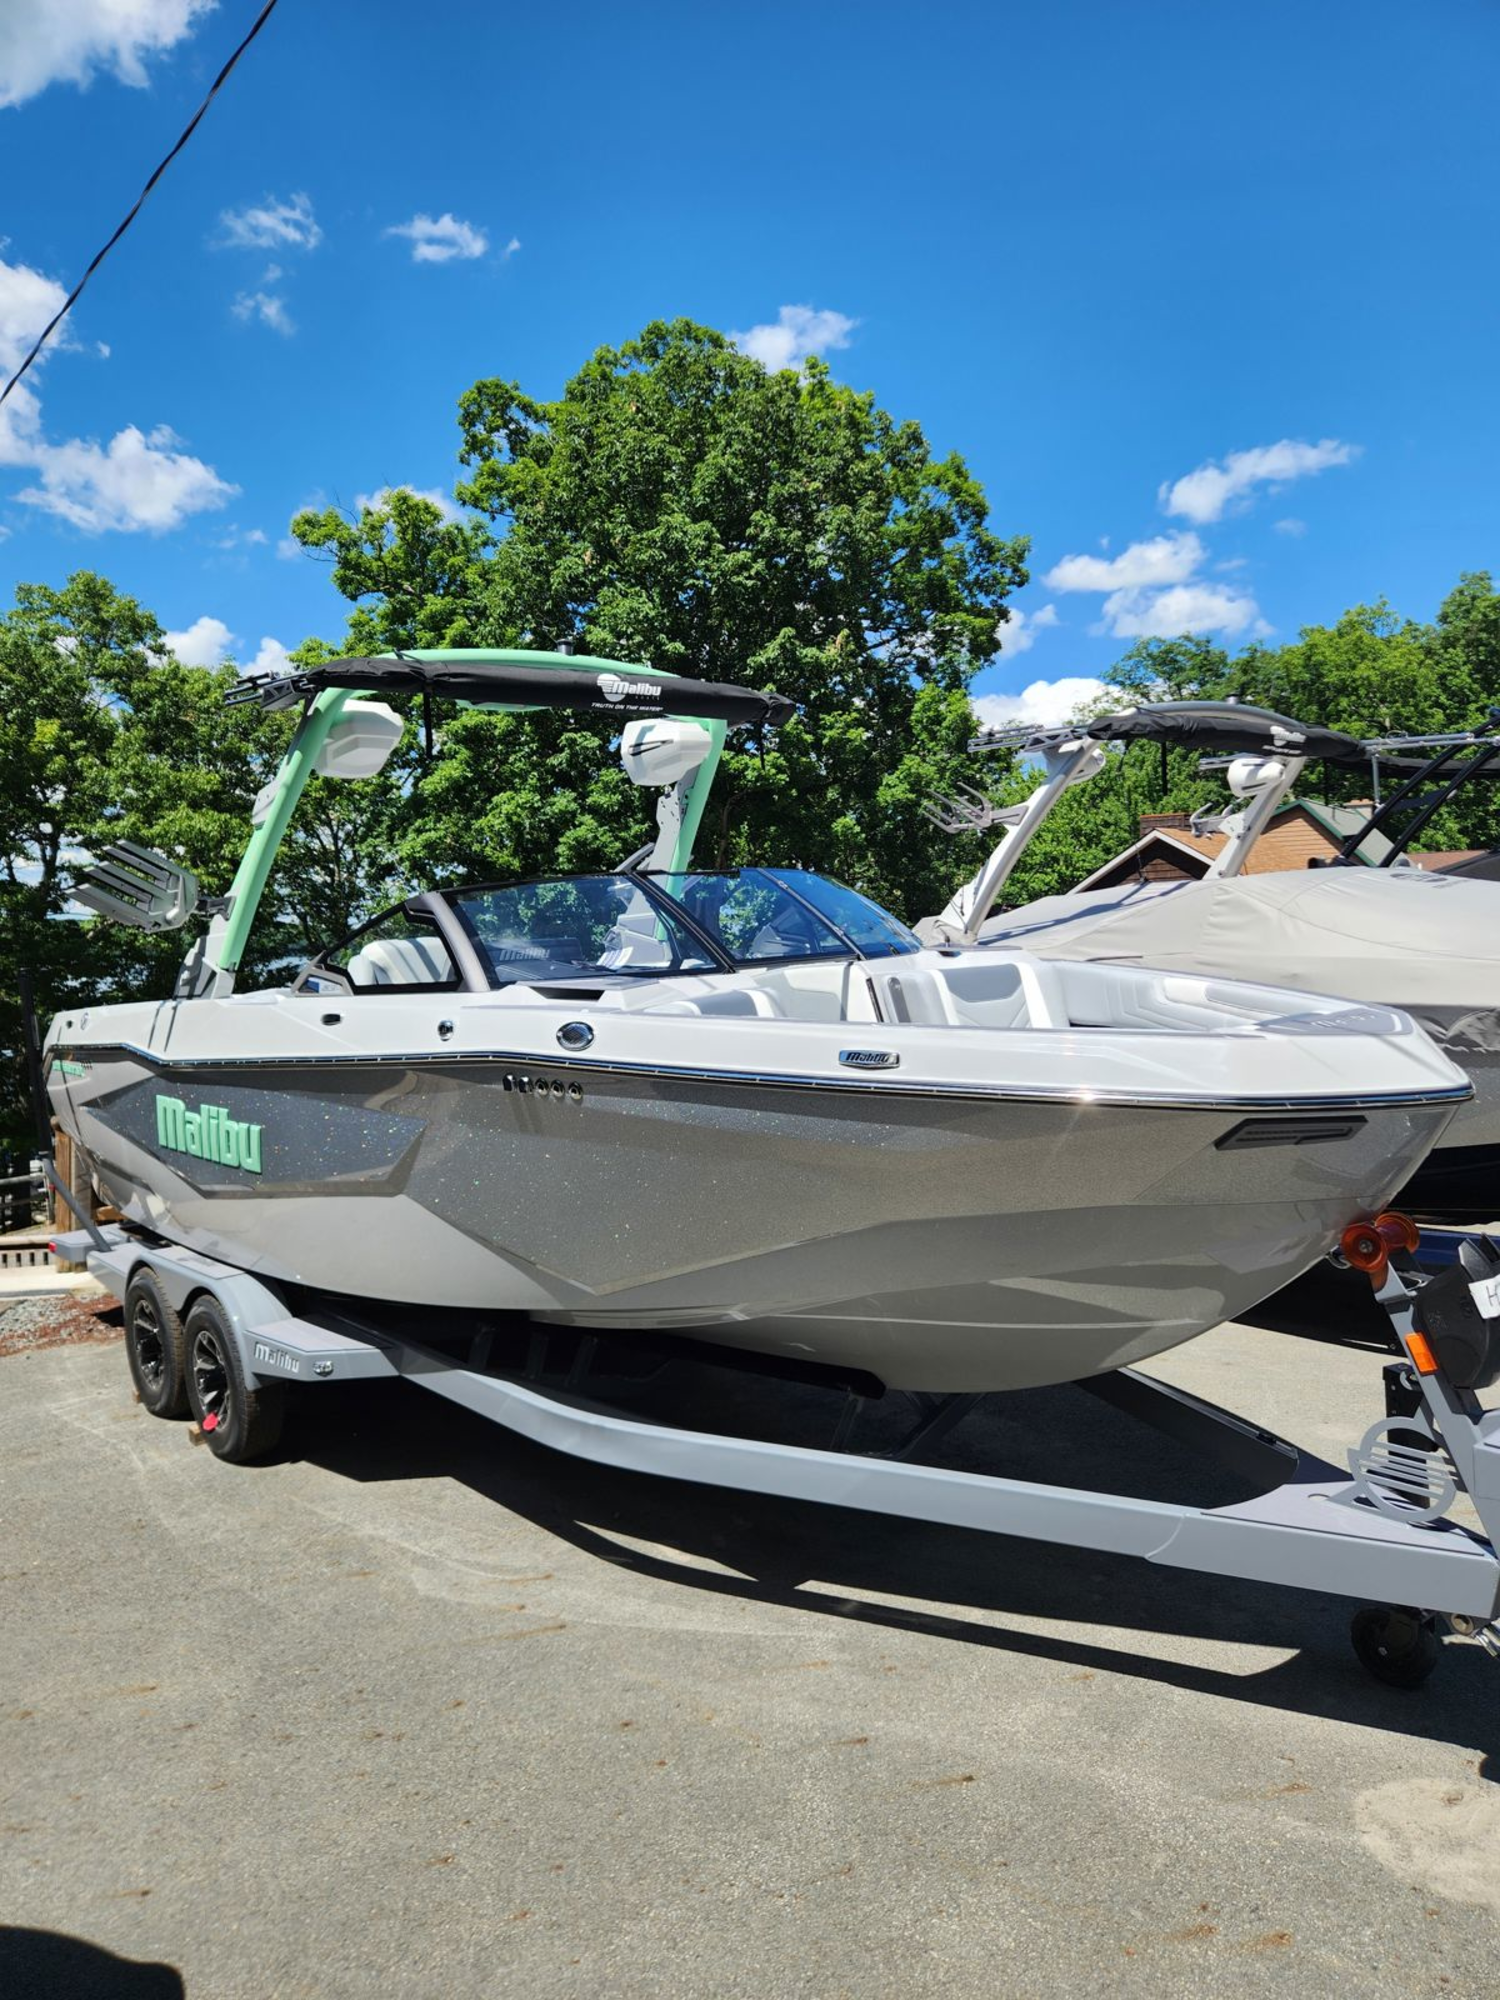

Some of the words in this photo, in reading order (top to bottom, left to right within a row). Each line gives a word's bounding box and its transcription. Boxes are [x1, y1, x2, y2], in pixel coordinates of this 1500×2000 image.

[612, 681, 661, 696] Malibu
[156, 1094, 262, 1174] Malibu
[254, 1341, 300, 1374] Malibu
